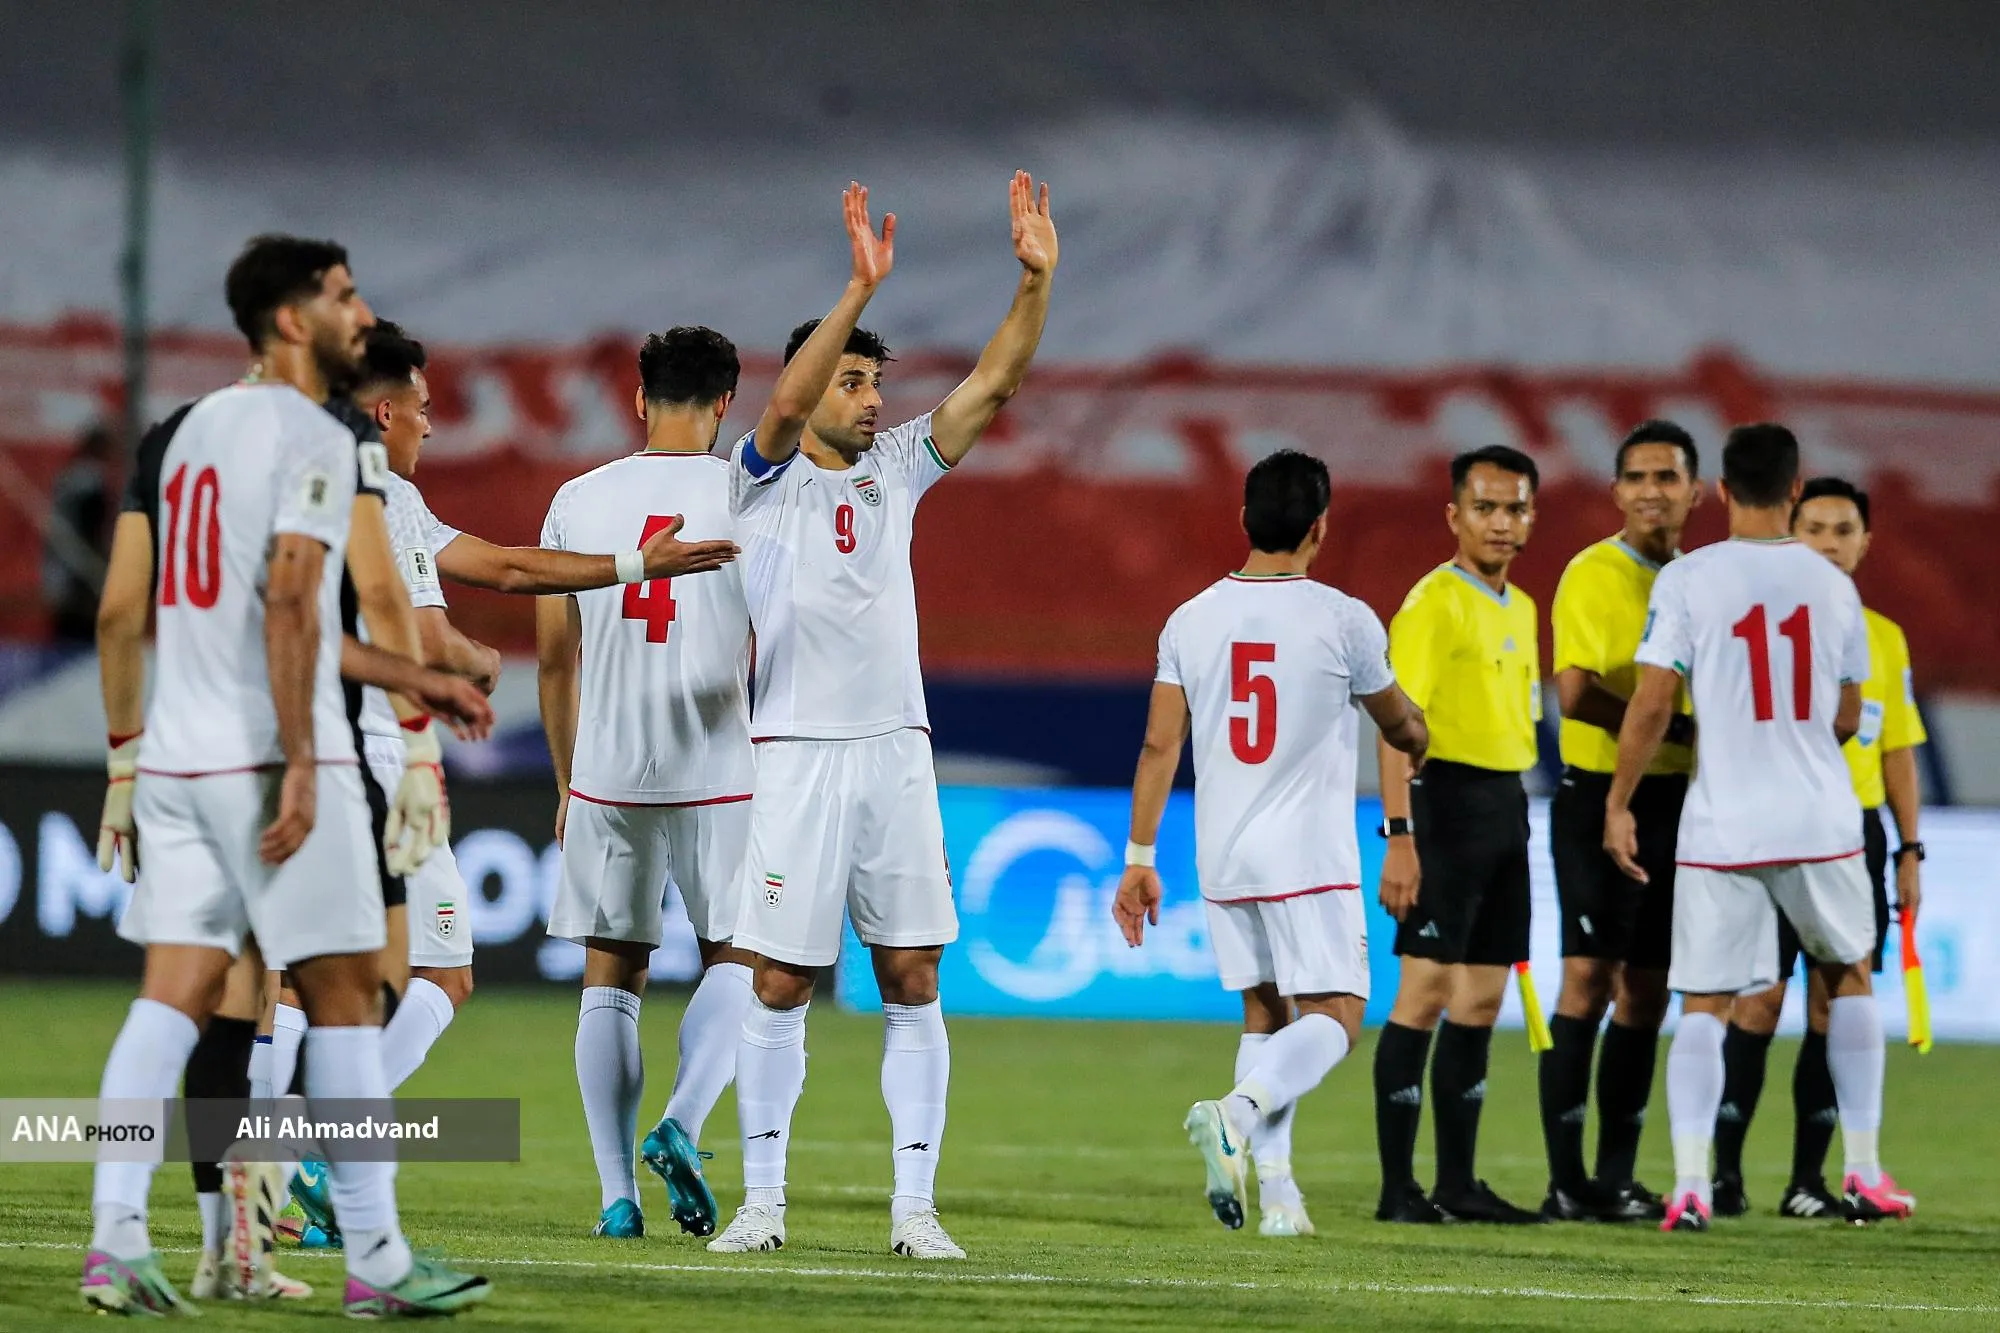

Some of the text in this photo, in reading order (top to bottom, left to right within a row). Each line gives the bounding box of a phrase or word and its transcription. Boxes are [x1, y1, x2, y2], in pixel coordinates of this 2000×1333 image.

[159, 463, 222, 609] 10
[622, 514, 677, 644] 4
[835, 504, 857, 554] 9
[1229, 641, 1278, 766] 5
[1731, 603, 1813, 722] 11
